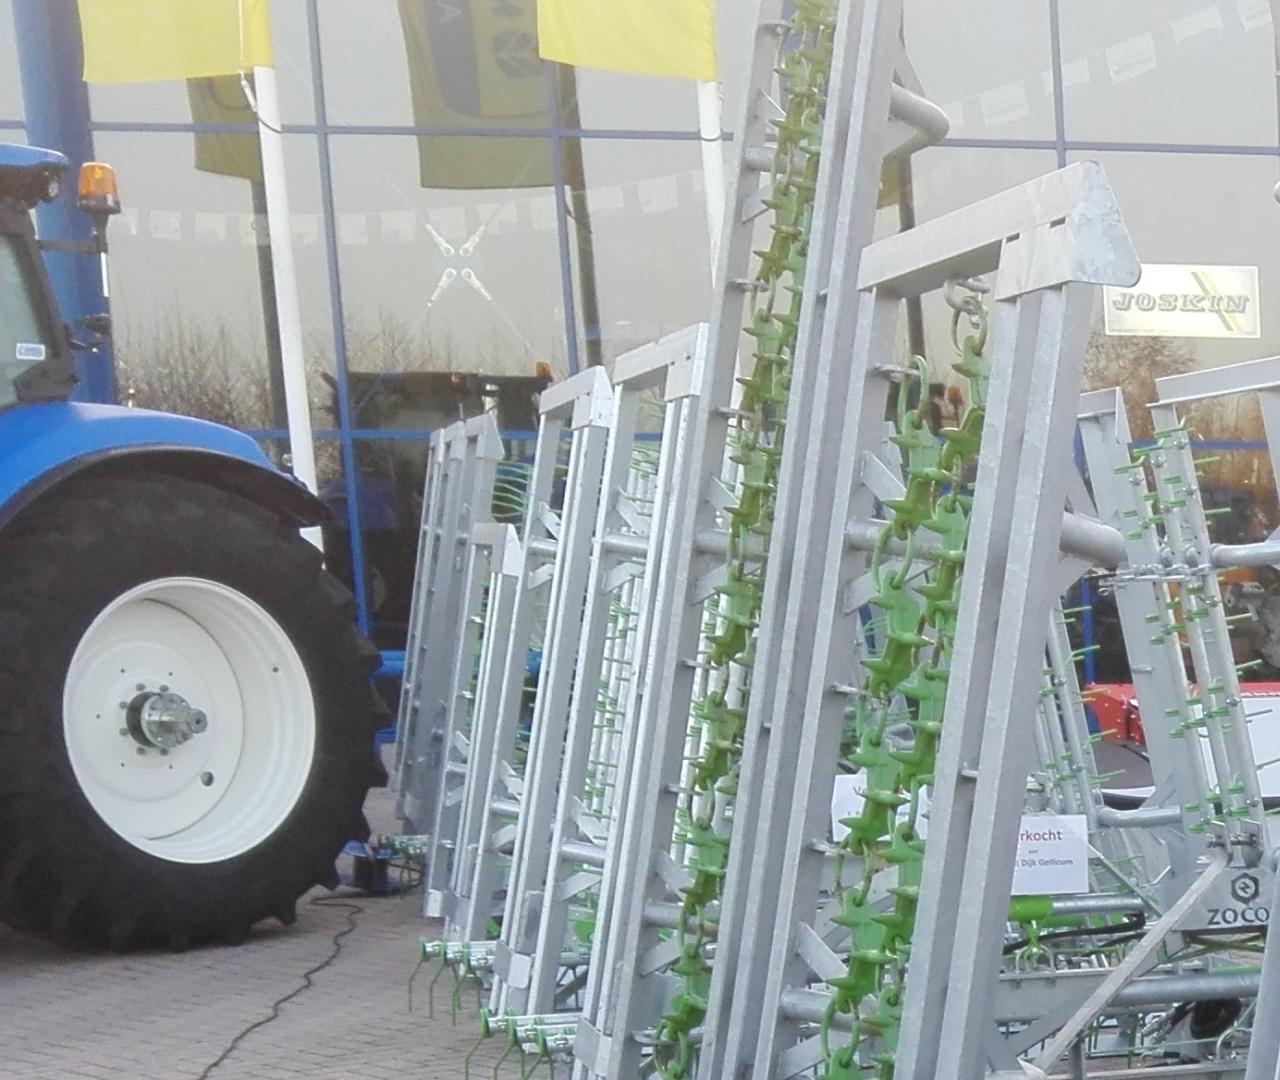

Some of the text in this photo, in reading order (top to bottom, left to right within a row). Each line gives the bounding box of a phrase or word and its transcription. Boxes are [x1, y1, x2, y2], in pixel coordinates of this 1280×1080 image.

[1112, 292, 1250, 313] JOSKIN
[1019, 829, 1063, 842] rkocht
[1021, 859, 1036, 868] Dijk
[1207, 907, 1270, 925] ZOCO
